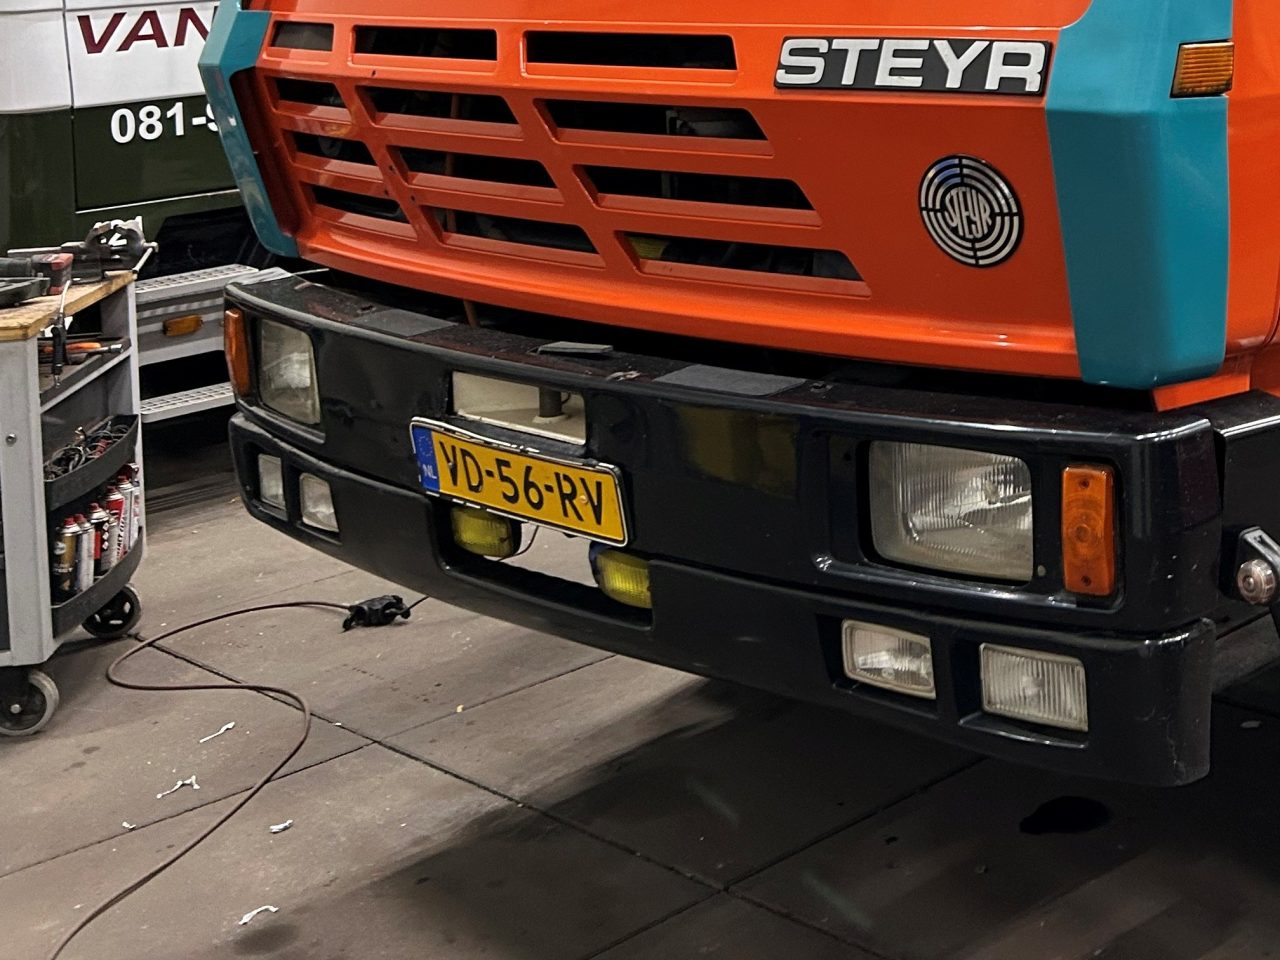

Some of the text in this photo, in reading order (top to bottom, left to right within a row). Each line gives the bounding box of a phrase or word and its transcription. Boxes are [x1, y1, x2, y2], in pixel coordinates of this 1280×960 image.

[776, 39, 1046, 93] STEYR
[944, 186, 992, 239] STEYR
[422, 463, 438, 480] NL
[439, 440, 603, 526] VD-56-RV
